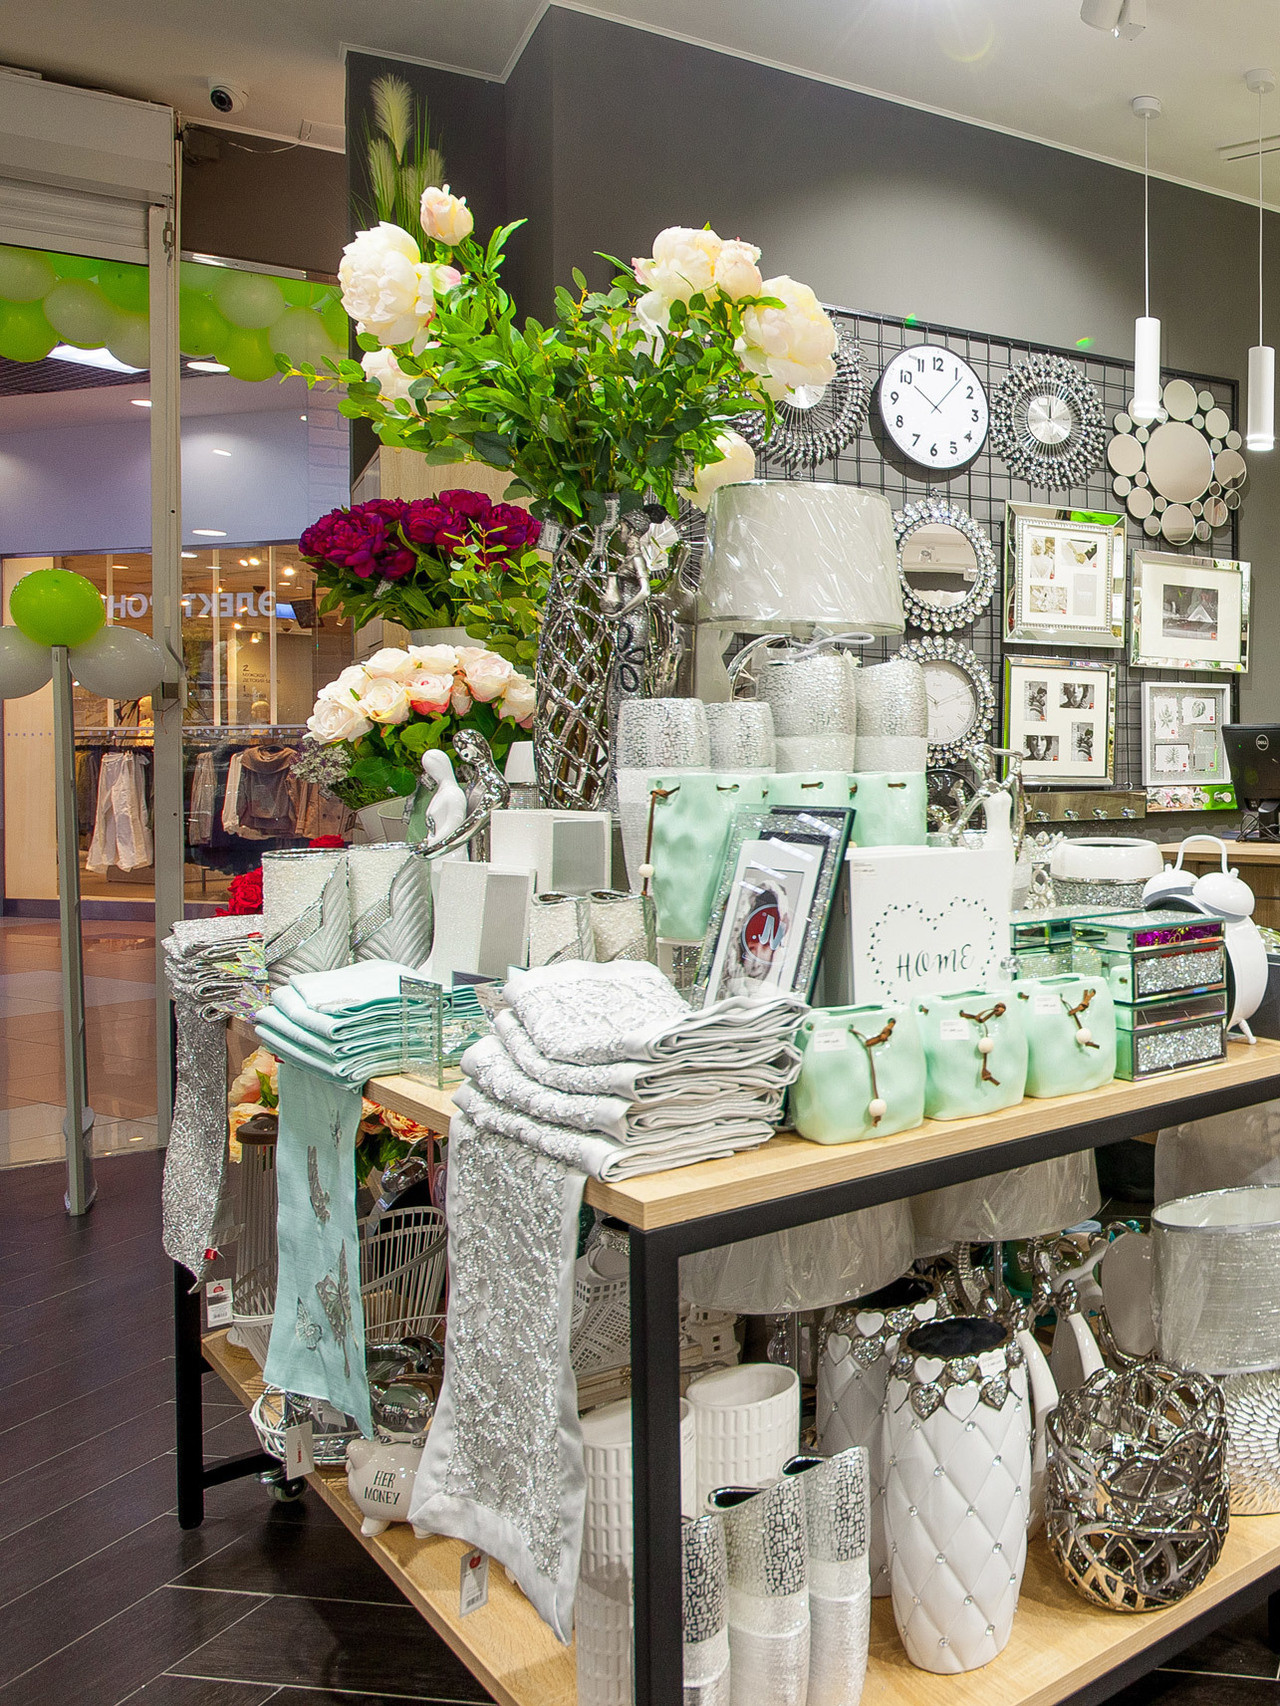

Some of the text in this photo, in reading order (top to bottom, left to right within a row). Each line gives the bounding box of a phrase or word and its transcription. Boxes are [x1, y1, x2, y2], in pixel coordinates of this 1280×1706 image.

[917, 358, 925, 373] 11
[932, 357, 944, 372] 12
[900, 369, 913, 385] 10
[954, 367, 959, 381] 1
[890, 391, 899, 405] 9
[965, 385, 974, 400] 2
[895, 414, 904, 428] 8
[971, 409, 979, 423] 3
[912, 433, 921, 447] 7
[963, 430, 973, 443] 4
[929, 443, 938, 457] 6
[949, 441, 958, 455] 5
[896, 943, 973, 982] HOME
[373, 1470, 396, 1488] HER
[364, 1486, 400, 1505] MONEY
